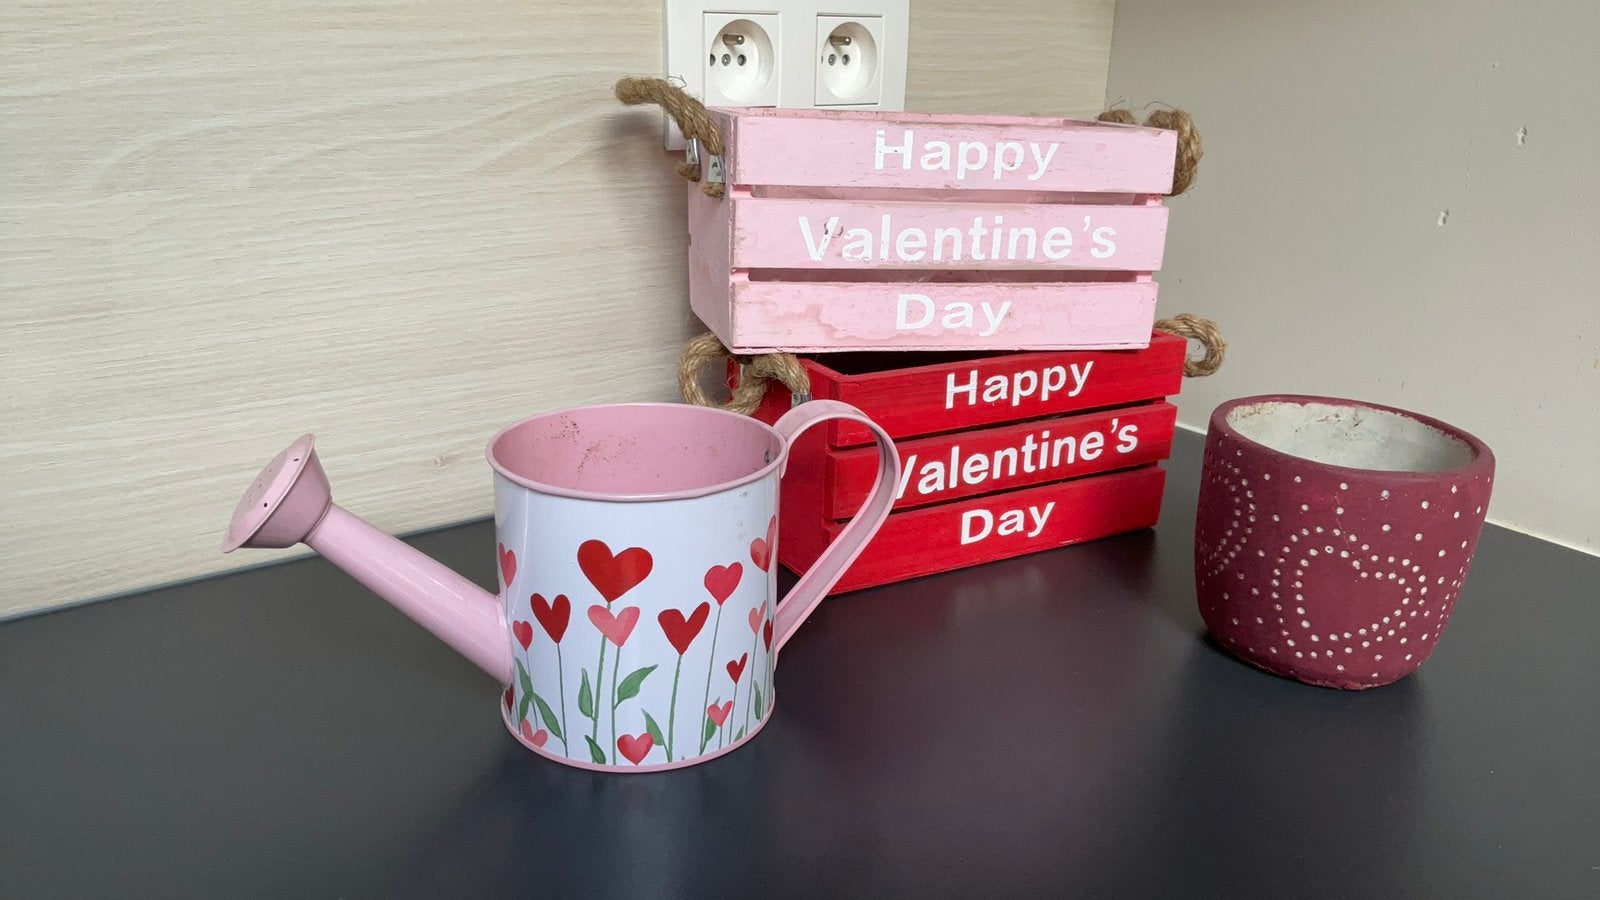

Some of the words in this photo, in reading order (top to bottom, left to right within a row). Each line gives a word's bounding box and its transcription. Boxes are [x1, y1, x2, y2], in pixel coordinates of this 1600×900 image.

[874, 130, 1059, 181] Happy
[798, 214, 1117, 263] Valentine's
[895, 293, 1012, 337] Day
[945, 360, 1094, 410] Happy
[960, 501, 1056, 545] Day
